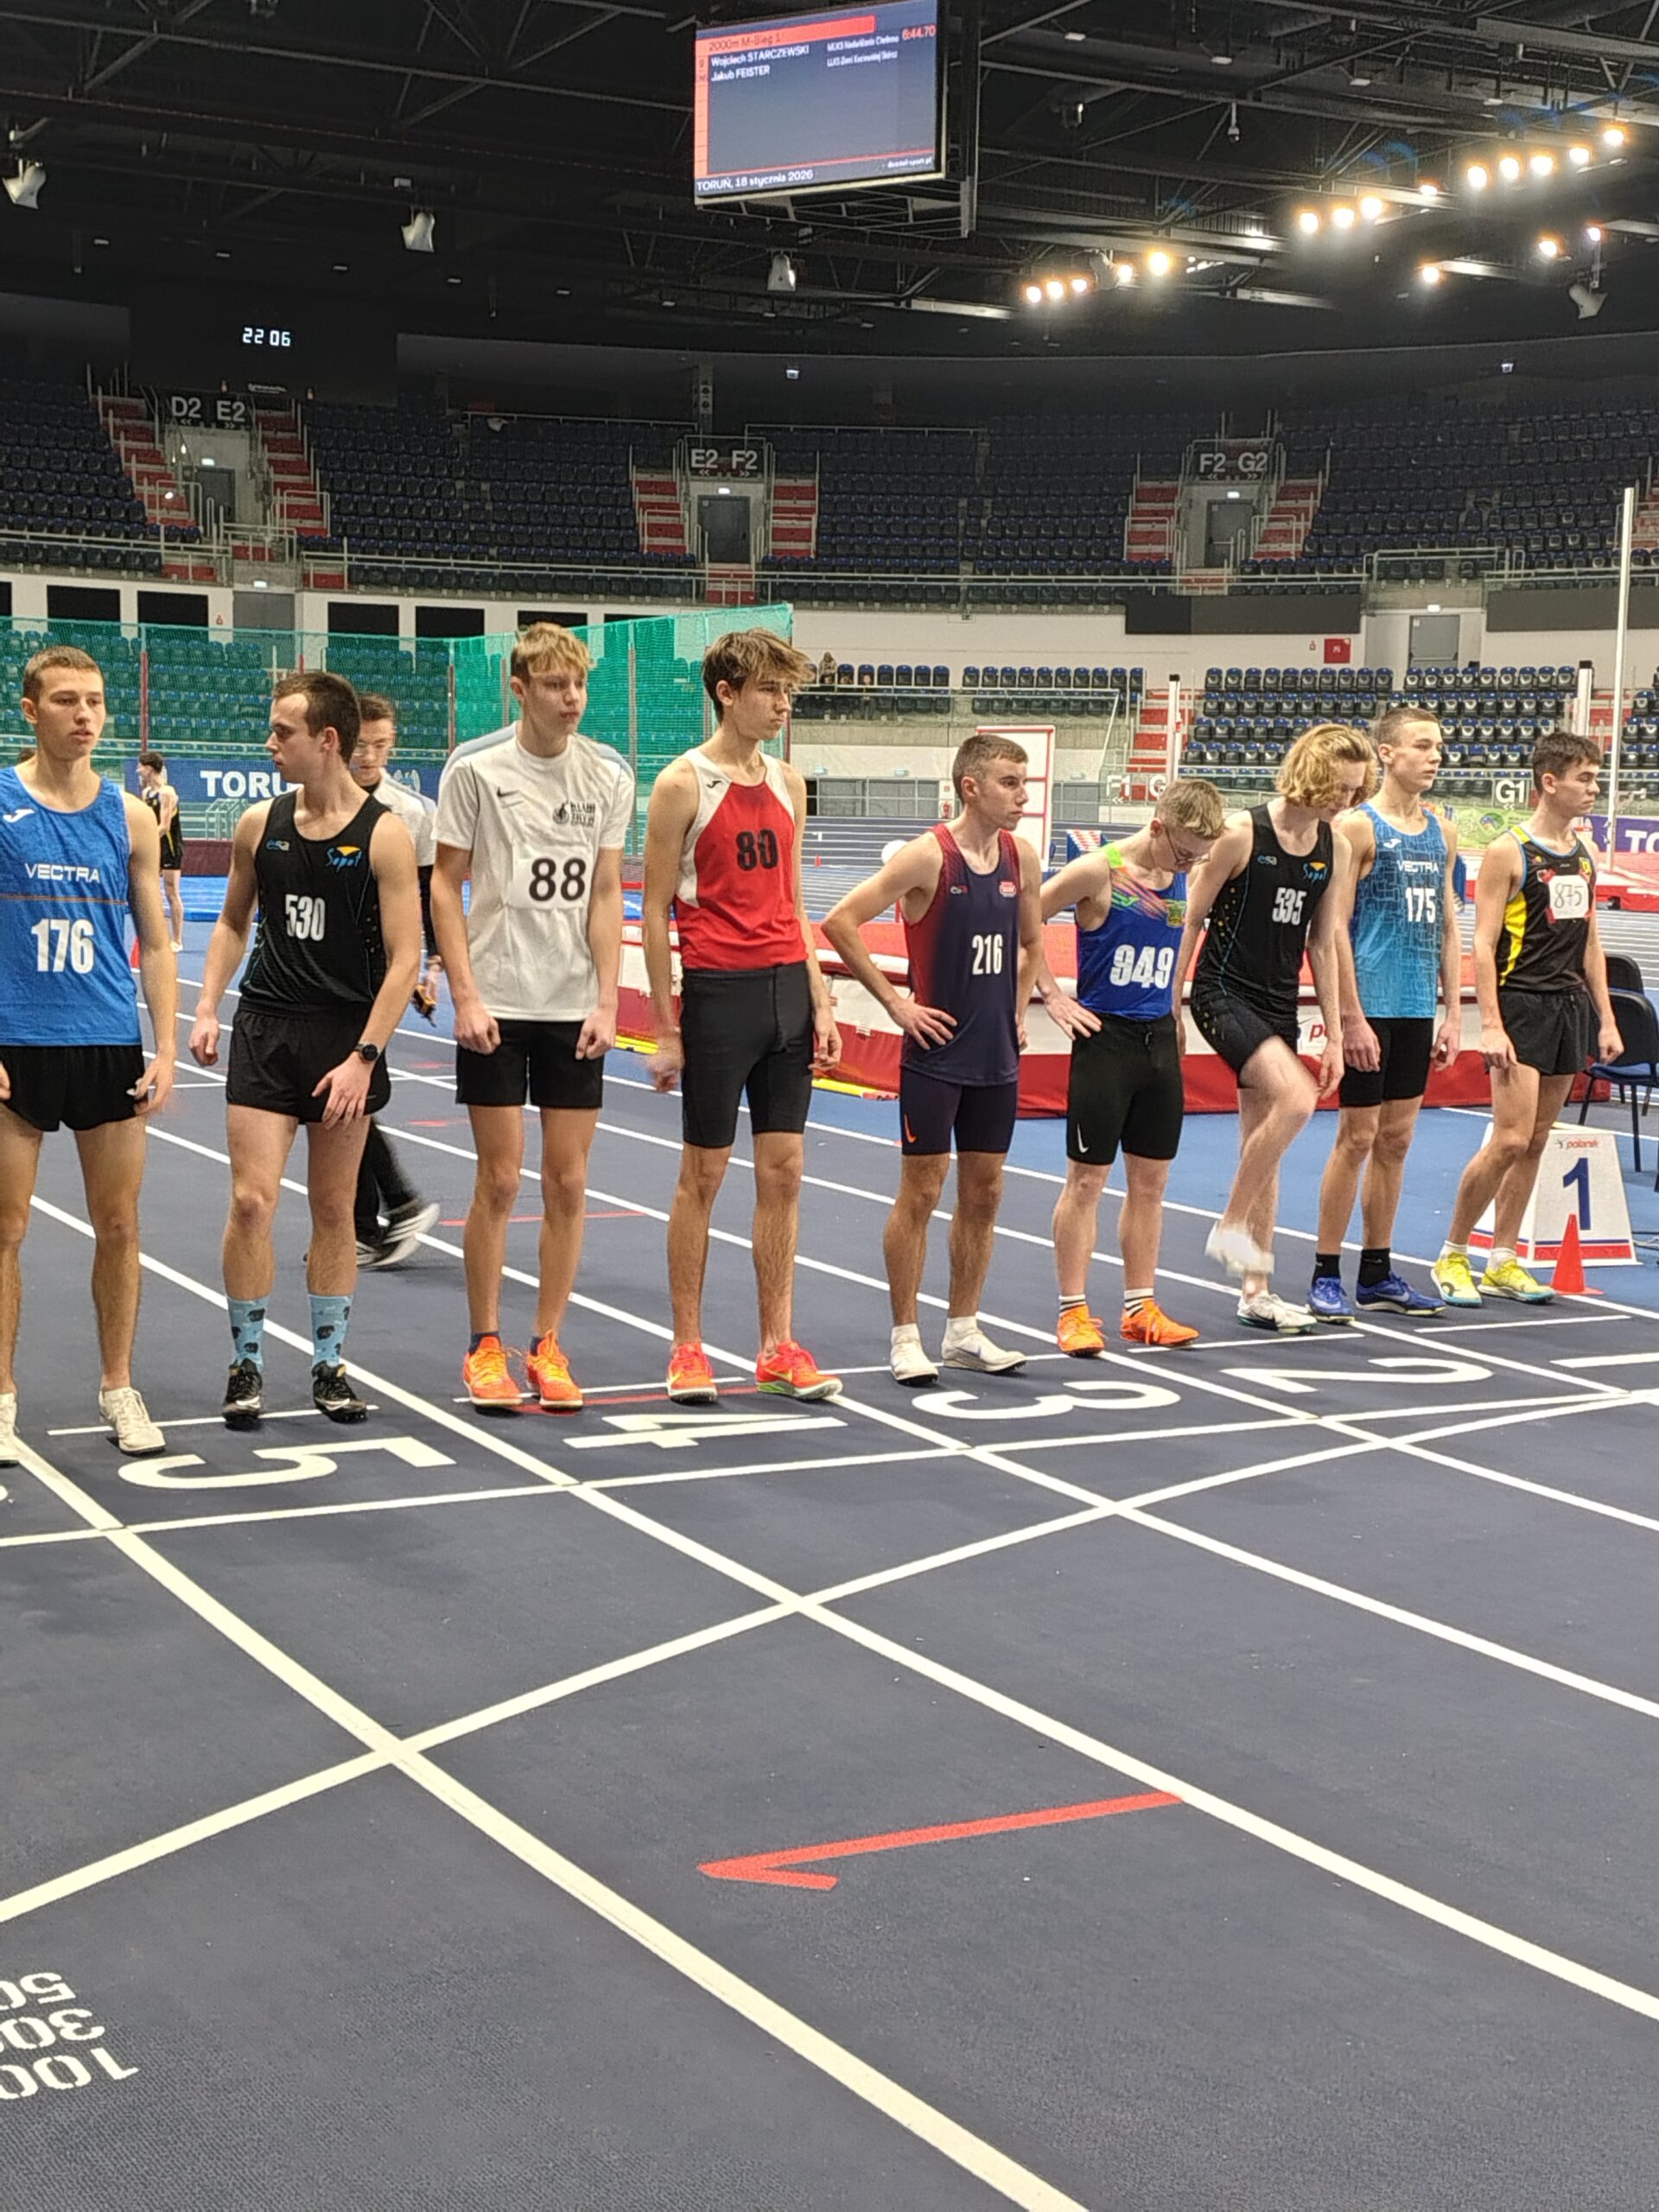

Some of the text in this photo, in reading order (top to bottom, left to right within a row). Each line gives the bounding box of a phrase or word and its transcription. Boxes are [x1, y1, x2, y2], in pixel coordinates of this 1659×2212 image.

[711, 45, 810, 67] Wojciech STARCZEWSKI
[711, 70, 734, 81] Jakub
[735, 65, 770, 79] FEISTER
[735, 176, 747, 187] 18
[749, 173, 786, 188] stycznia
[788, 169, 813, 181] 2026
[172, 396, 245, 423] D2 E2
[691, 448, 758, 469] E2 F2
[1199, 452, 1268, 473] F2 G2
[1107, 774, 1131, 796] F1
[1496, 779, 1526, 804] G1
[736, 828, 778, 871] 80
[1396, 860, 1440, 874] VECTRA
[24, 863, 100, 883] VECTRA
[529, 857, 587, 901] 88
[285, 893, 325, 941] 530
[1272, 887, 1307, 925] 535
[1405, 887, 1436, 923] 175
[31, 918, 94, 974] 176
[972, 933, 1002, 975] 216
[1109, 944, 1174, 989] 949
[1563, 1158, 1592, 1230] 1
[1219, 1357, 1495, 1394] 2
[912, 1382, 1181, 1420] 3
[563, 1413, 848, 1449] 4
[118, 1436, 457, 1490] 5
[0, 2009, 105, 2054] 30
